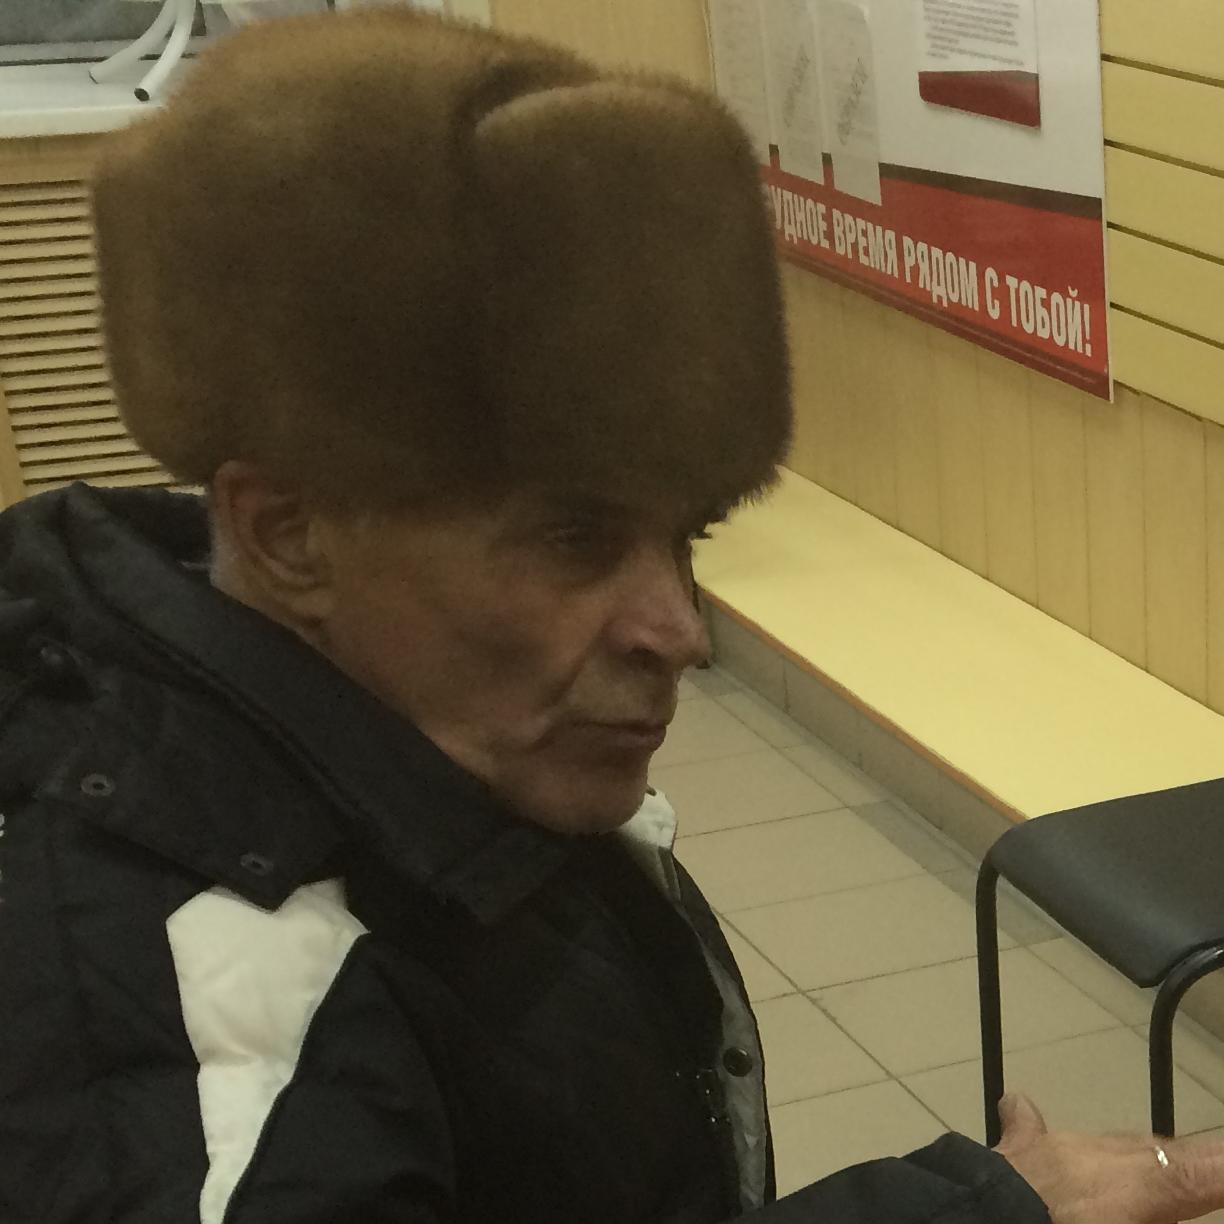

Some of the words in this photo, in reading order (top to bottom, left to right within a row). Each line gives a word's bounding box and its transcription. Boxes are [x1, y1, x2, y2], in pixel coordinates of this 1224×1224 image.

[832, 208, 899, 278] ВРЕМЯ
[903, 235, 979, 312] РЯДОМ
[985, 266, 1000, 320] С
[1006, 274, 1092, 357] ТОБОЙ!
